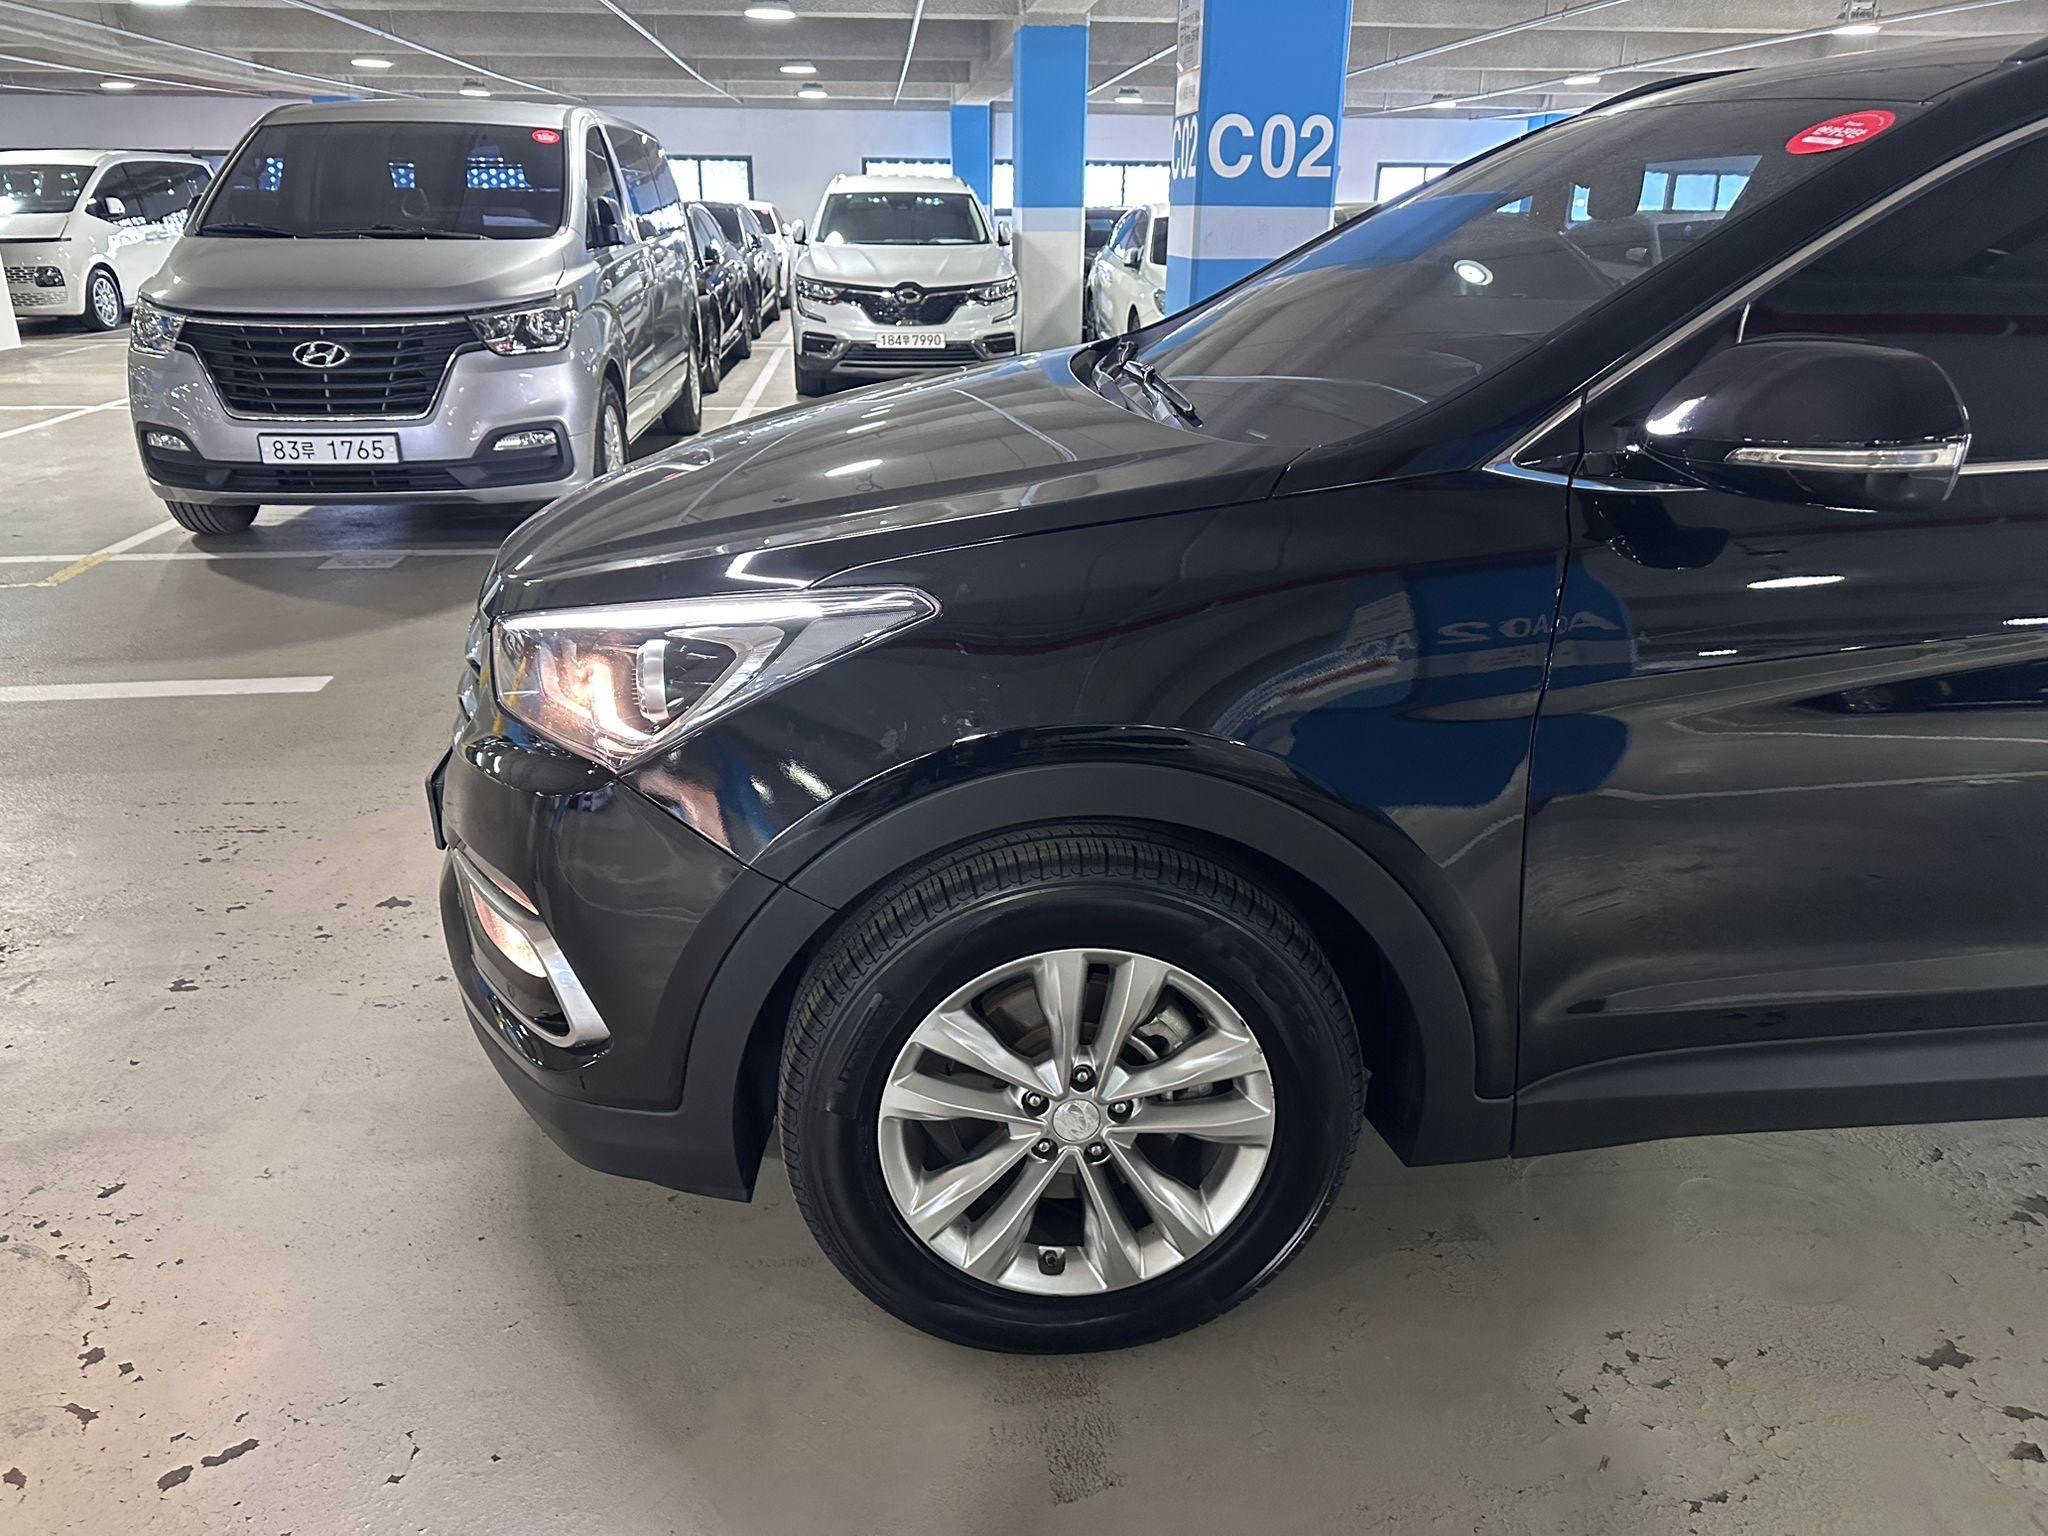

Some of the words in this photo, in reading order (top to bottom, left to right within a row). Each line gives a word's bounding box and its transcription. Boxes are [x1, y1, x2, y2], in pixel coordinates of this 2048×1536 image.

[1171, 114, 1199, 180] C02
[1208, 113, 1335, 179] C02
[273, 440, 315, 460] 83루
[327, 440, 385, 460] 1765
